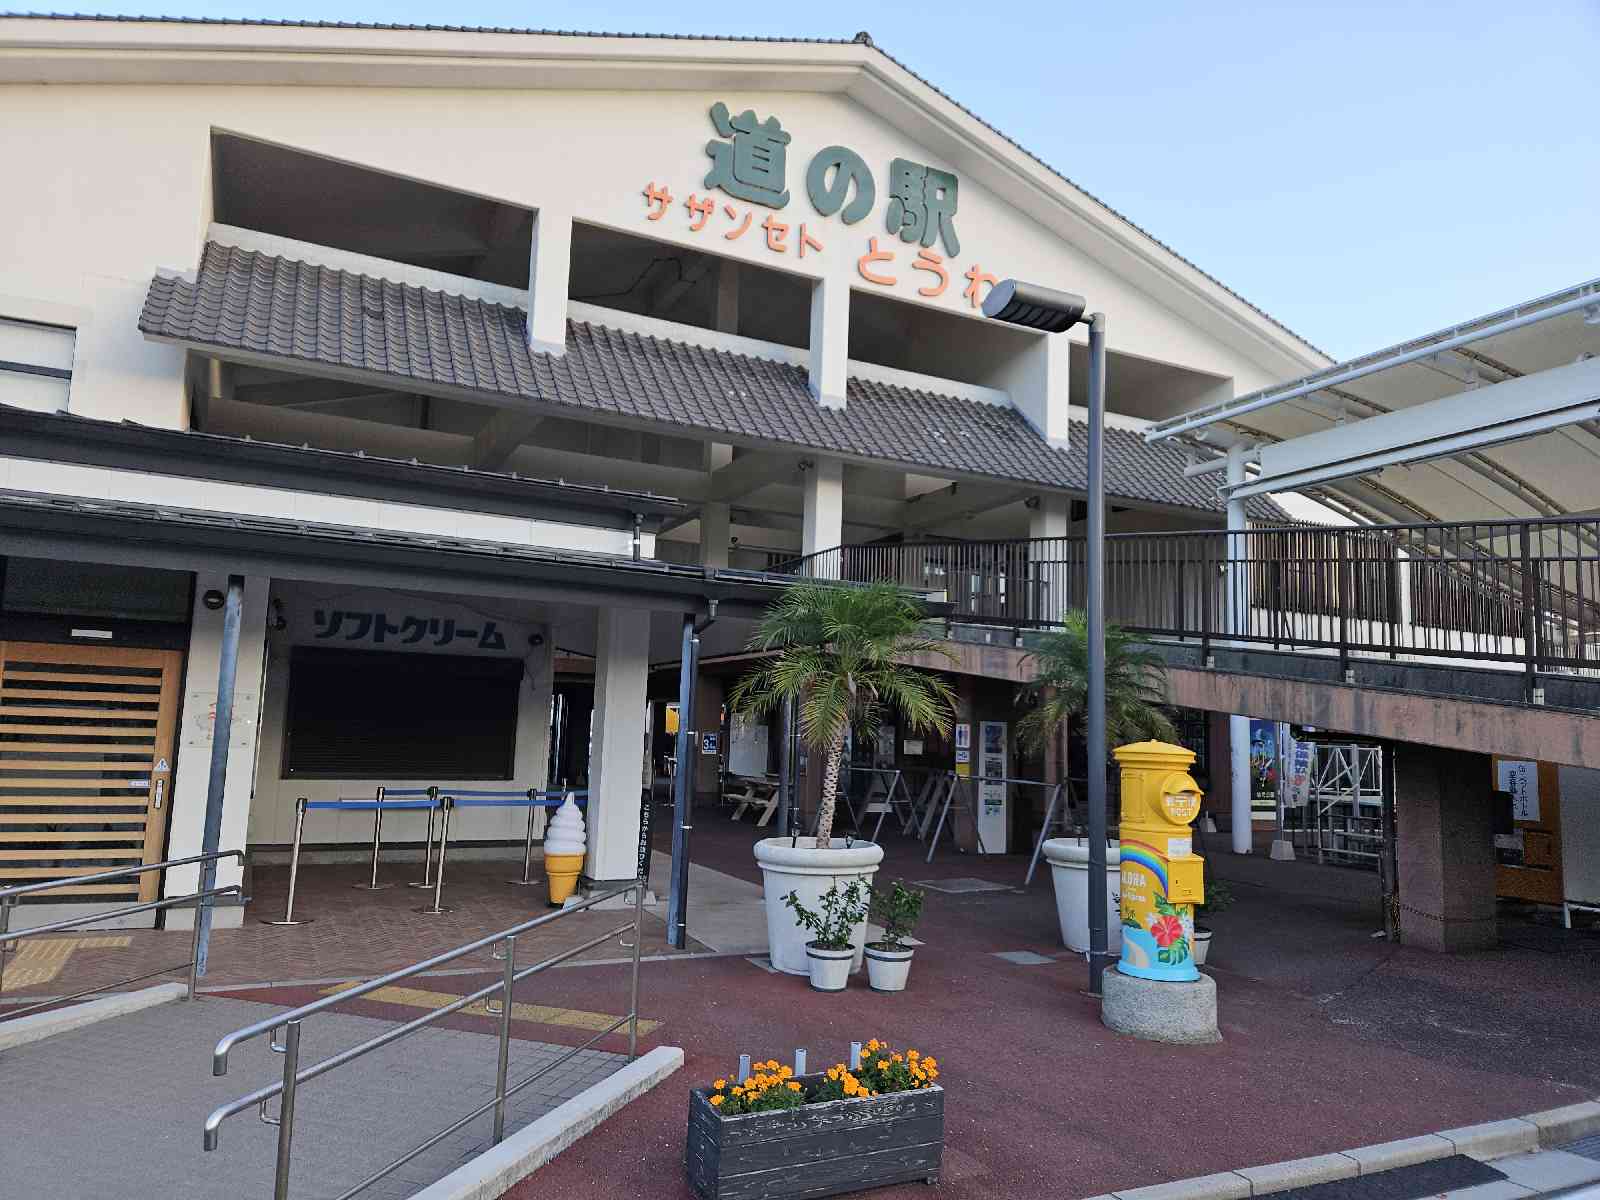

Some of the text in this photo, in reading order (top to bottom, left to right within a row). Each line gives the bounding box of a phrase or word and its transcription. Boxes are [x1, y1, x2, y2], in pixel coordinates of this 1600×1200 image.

[703, 101, 961, 258] 道の駅
[642, 181, 824, 259] サザンセト
[313, 608, 507, 650] ソフトクリーム
